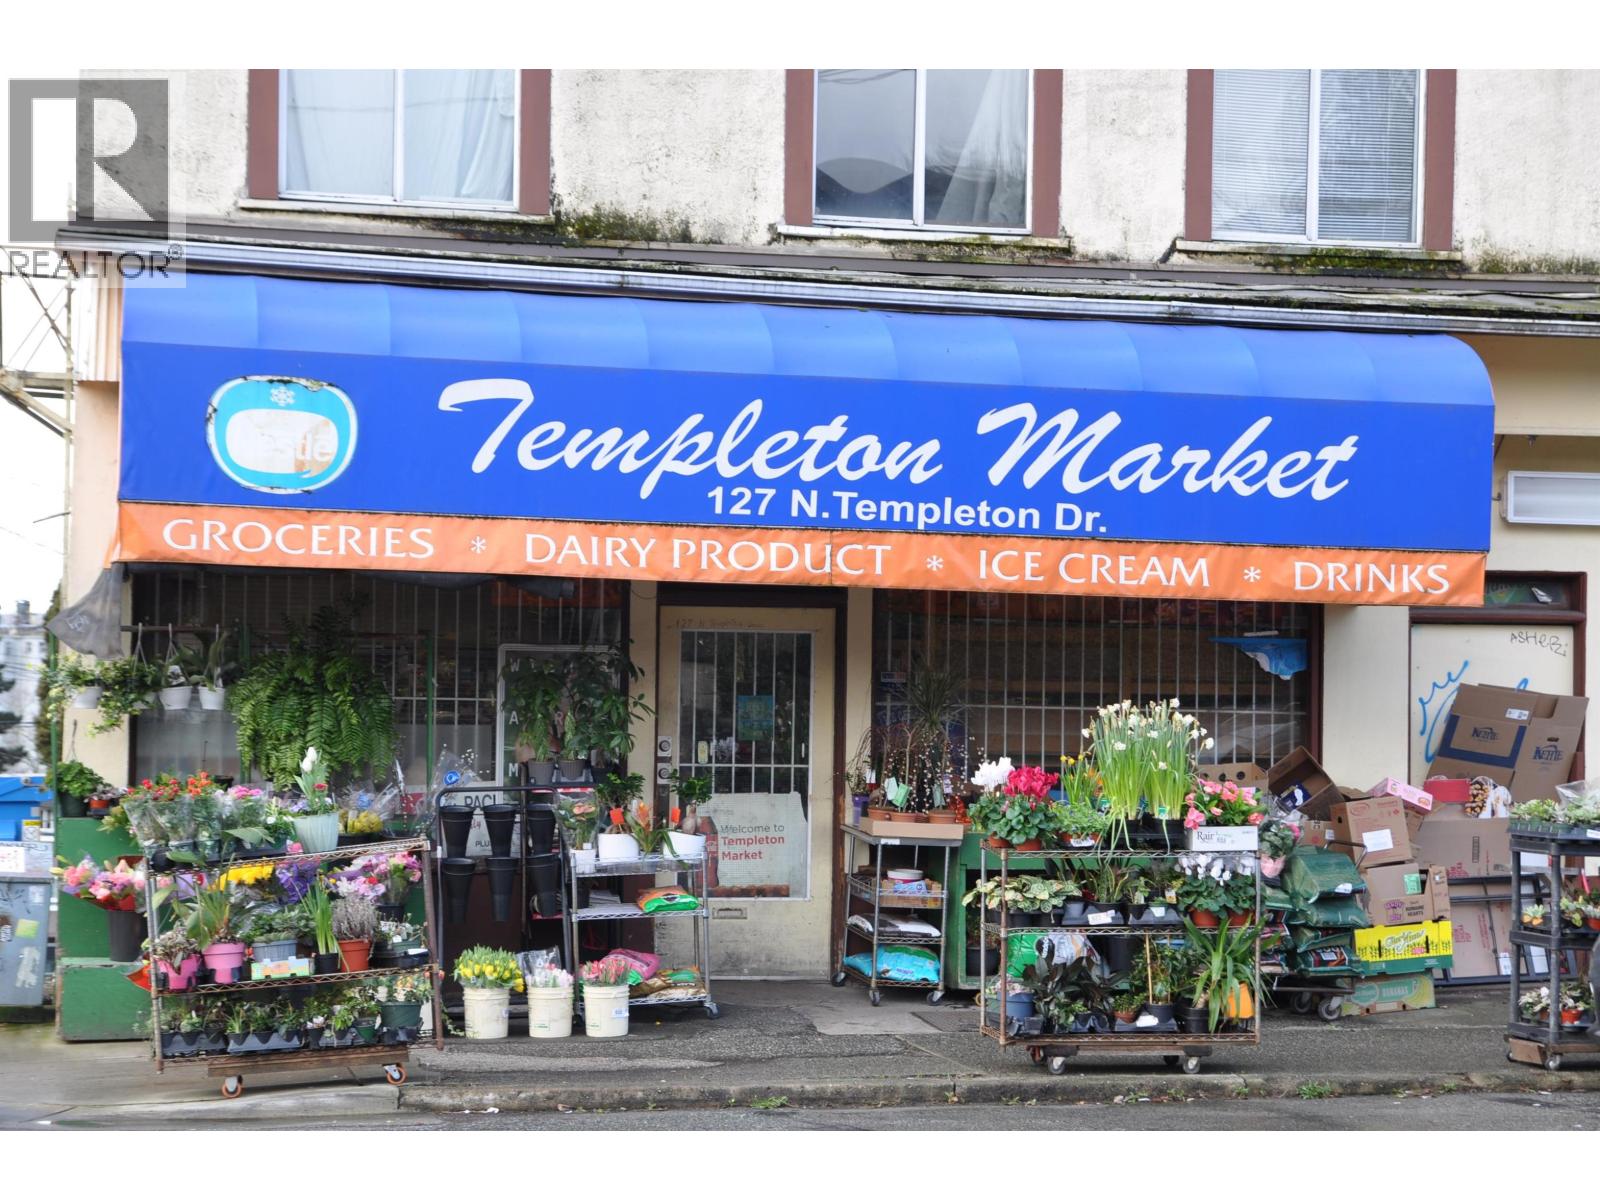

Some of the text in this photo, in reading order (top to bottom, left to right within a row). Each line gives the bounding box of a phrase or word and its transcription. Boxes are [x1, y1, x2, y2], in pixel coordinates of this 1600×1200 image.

[438, 378, 1359, 501] Templeton Market
[707, 485, 777, 517] 127
[1055, 502, 1107, 534] Dr.
[162, 518, 436, 562] GROCERIES
[524, 532, 893, 579] DAIRY PRODUCT
[979, 549, 1211, 588] ICE CREAM
[1293, 561, 1450, 596] DRINKS
[720, 824, 785, 834] Welcome to
[720, 835, 785, 847] Templeton
[721, 850, 763, 861] Market
